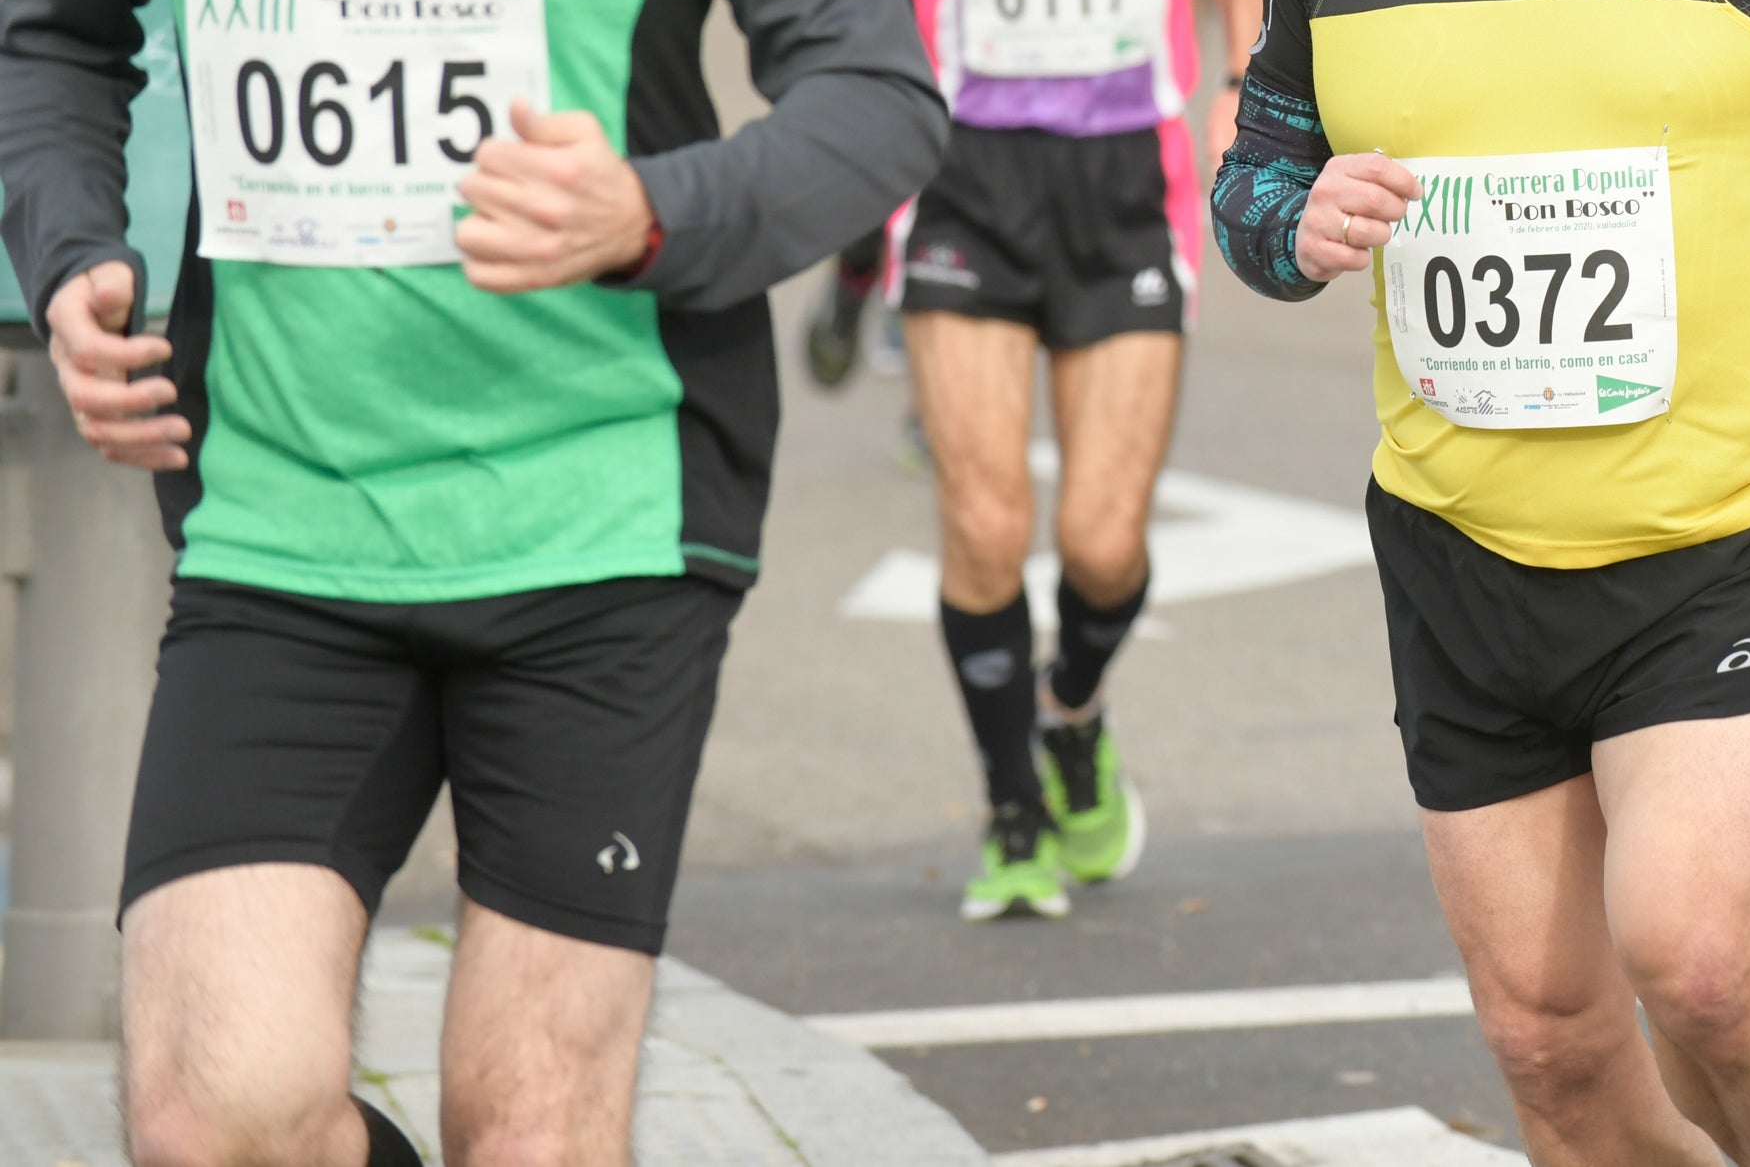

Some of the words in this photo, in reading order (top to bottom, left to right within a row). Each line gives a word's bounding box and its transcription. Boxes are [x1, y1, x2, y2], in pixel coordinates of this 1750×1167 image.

[236, 59, 494, 166] 0615
[1484, 172, 1565, 196] Carrera
[1572, 165, 1659, 195] Popular
[1491, 199, 1556, 221] "Don
[1566, 191, 1655, 219] Bosco"
[1509, 225, 1515, 234] 9
[1516, 225, 1526, 233] de
[1527, 224, 1560, 233] febrero
[1562, 223, 1571, 232] de
[1574, 222, 1595, 232] 2020,
[1596, 220, 1637, 230] Valladolid
[1424, 249, 1633, 348] 0372
[1420, 356, 1478, 371] "Corriendo
[1483, 360, 1496, 371] en
[1500, 356, 1511, 370] el
[1515, 356, 1555, 371] barrio,
[1560, 355, 1593, 368] como
[1599, 354, 1614, 366] en
